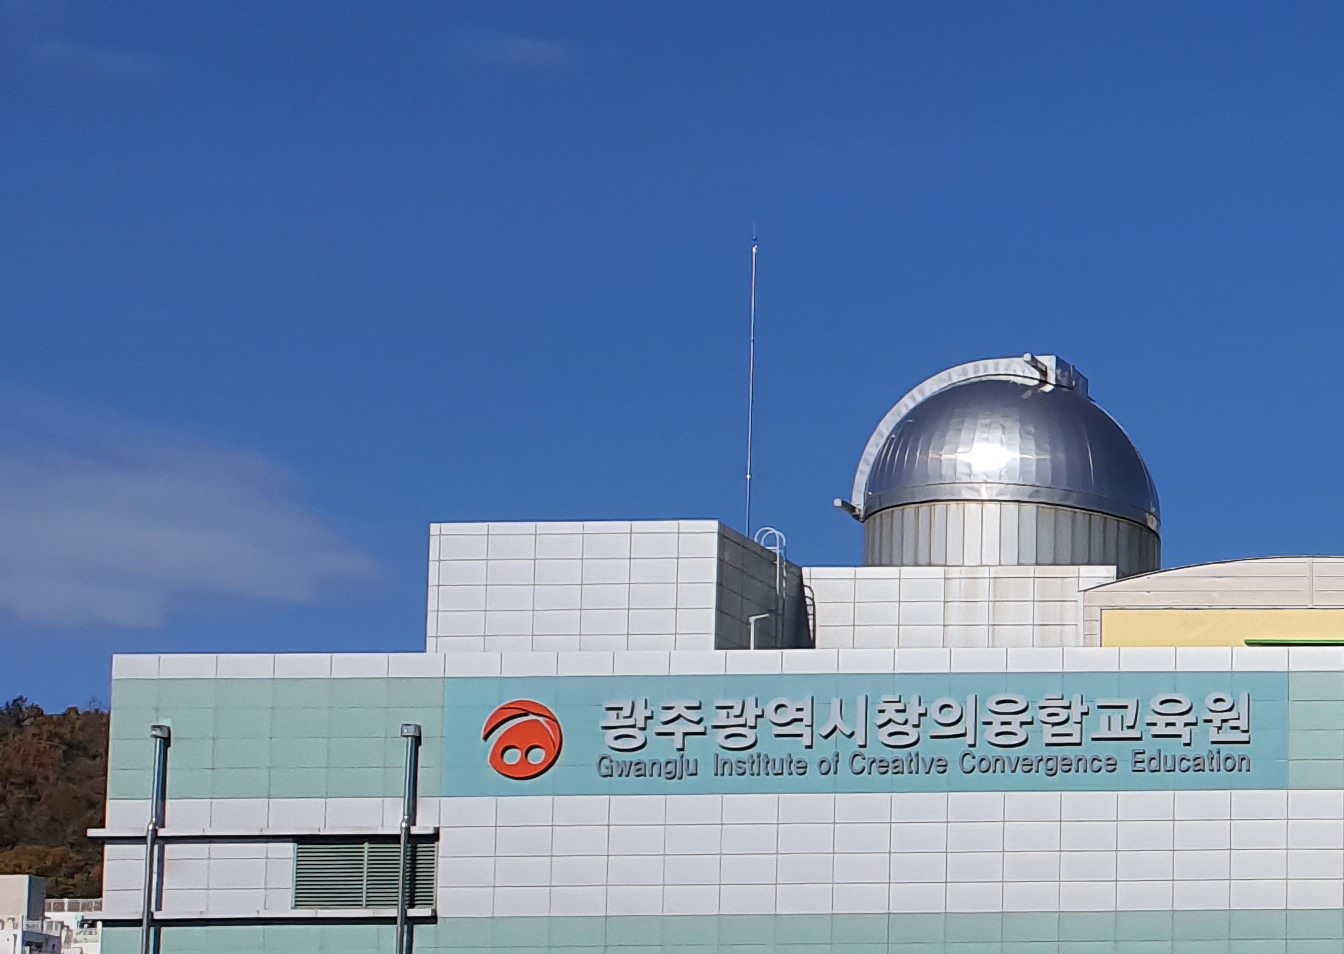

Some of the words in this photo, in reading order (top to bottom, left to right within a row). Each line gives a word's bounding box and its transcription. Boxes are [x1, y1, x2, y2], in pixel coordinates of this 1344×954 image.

[600, 694, 1250, 751] 광주광역시창의융합교육원
[595, 753, 699, 780] Gwangju
[712, 751, 808, 777] Institute
[817, 750, 840, 776] of
[848, 750, 949, 776] Creative
[958, 751, 1118, 777] Convergence
[1130, 748, 1251, 774] Education
